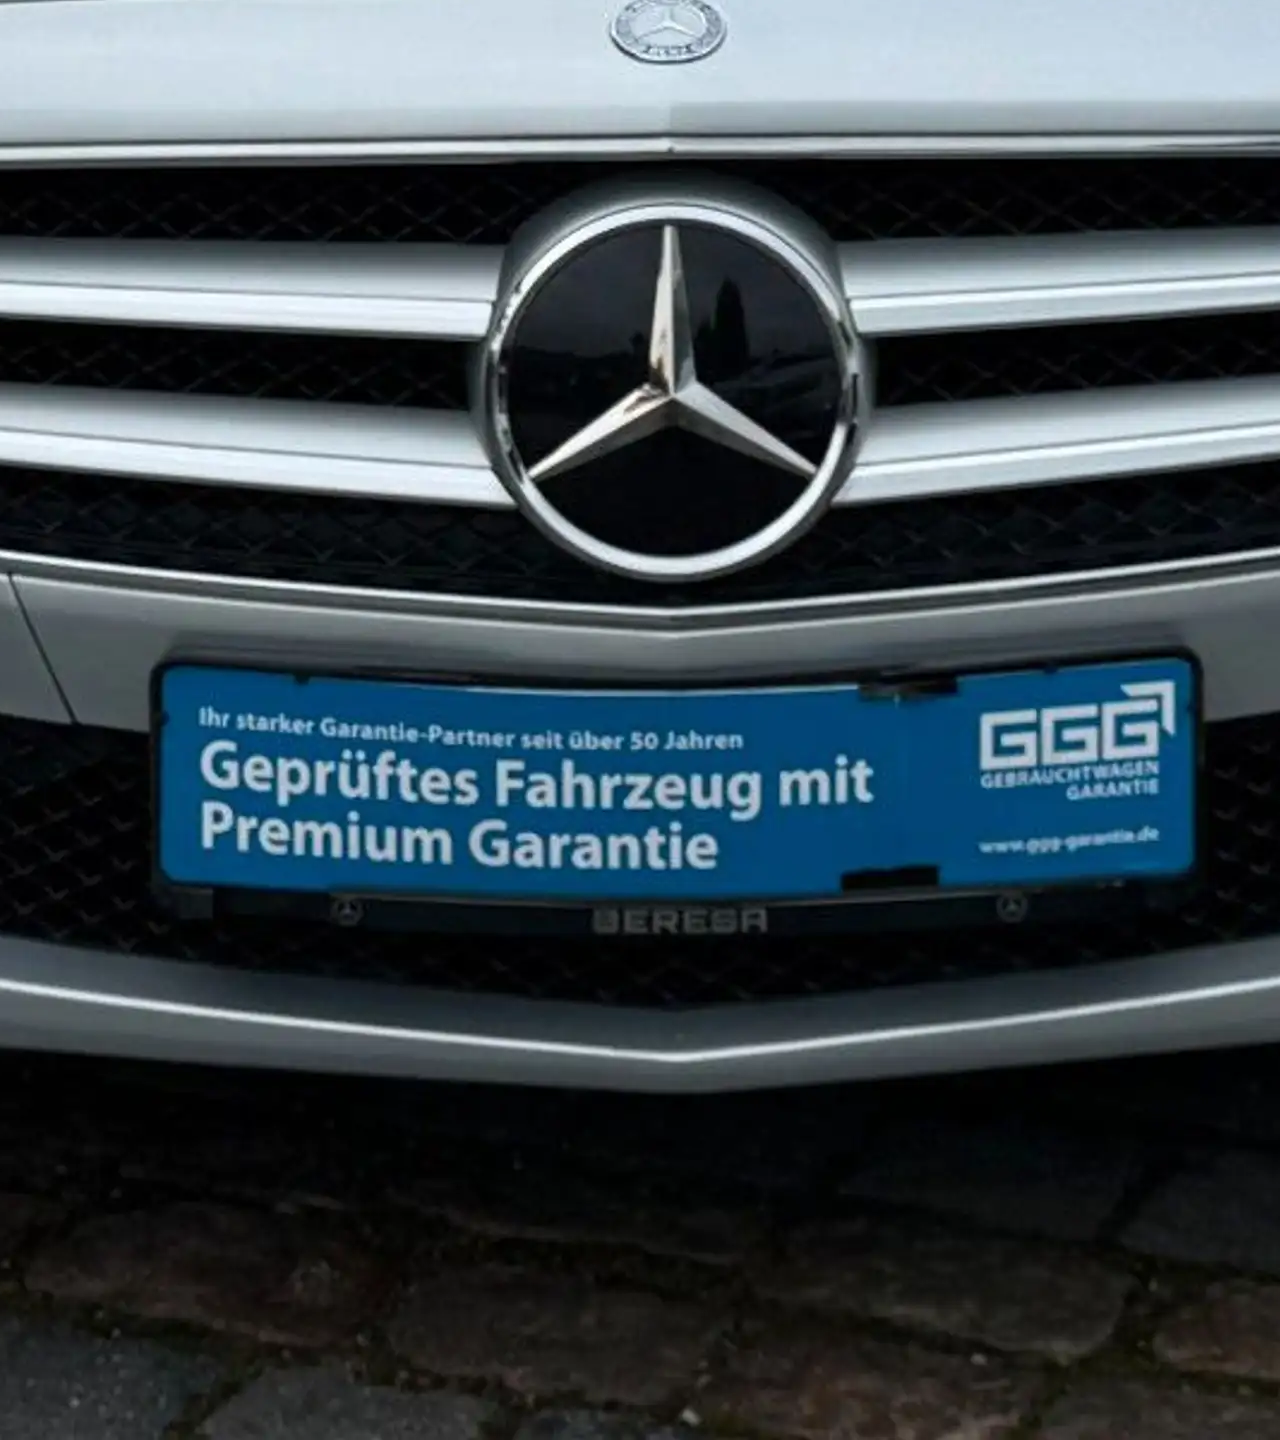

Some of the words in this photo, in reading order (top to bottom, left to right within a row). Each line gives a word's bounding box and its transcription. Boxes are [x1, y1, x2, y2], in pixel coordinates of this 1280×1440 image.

[198, 706, 229, 728] Ihr
[236, 712, 314, 736] starker
[320, 717, 516, 748] Garantie-Partner
[521, 730, 564, 751] seit
[570, 729, 624, 751] über
[630, 731, 660, 751] 50
[663, 729, 744, 751] Jahren
[979, 698, 1160, 771] GGG
[199, 739, 480, 807] Geprüftes
[496, 758, 761, 822] Fahrzeug
[778, 755, 874, 806] mit
[980, 760, 1160, 790] GEBRAUCHTWAGEN
[1065, 777, 1160, 801] GARANTIE
[201, 801, 453, 865] Premium
[469, 818, 719, 870] Garantie
[978, 825, 1160, 856] www.ggg-garantie.de
